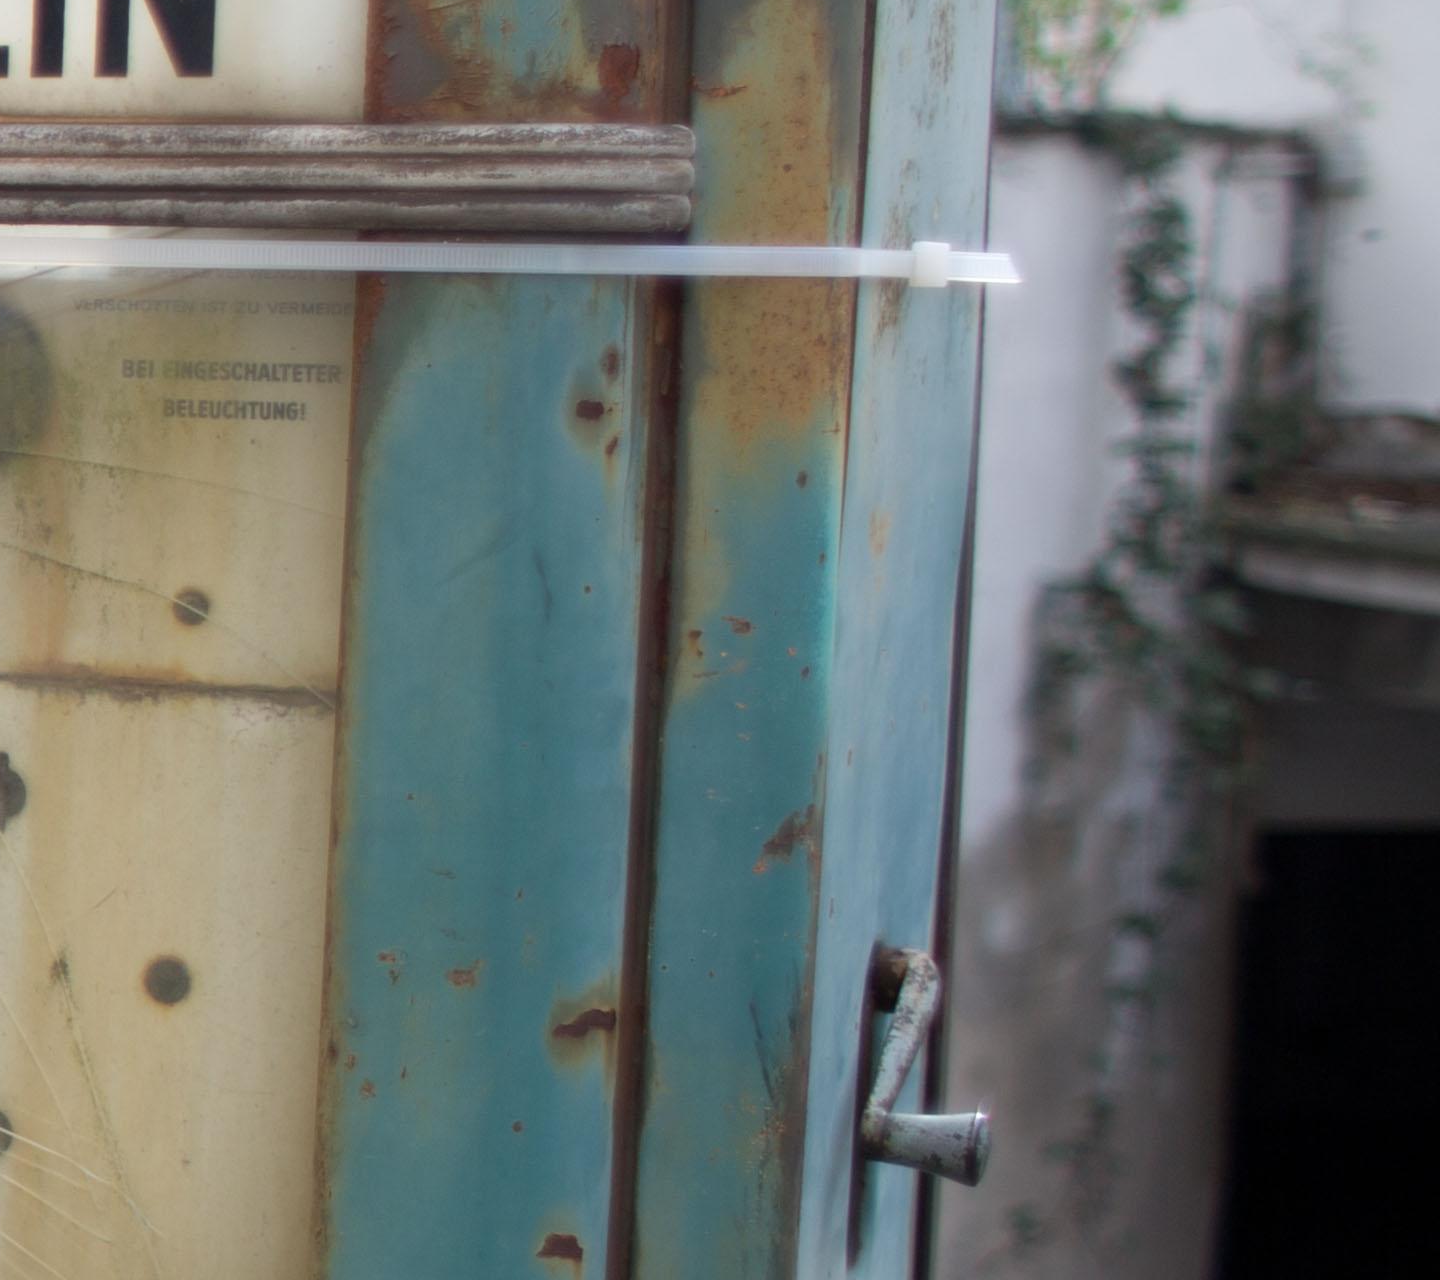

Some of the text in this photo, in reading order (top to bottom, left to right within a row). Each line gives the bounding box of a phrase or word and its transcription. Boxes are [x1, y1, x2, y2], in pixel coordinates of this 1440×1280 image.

[235, 302, 261, 315] ZU
[122, 359, 342, 384] BEI EINGESCHALTETER
